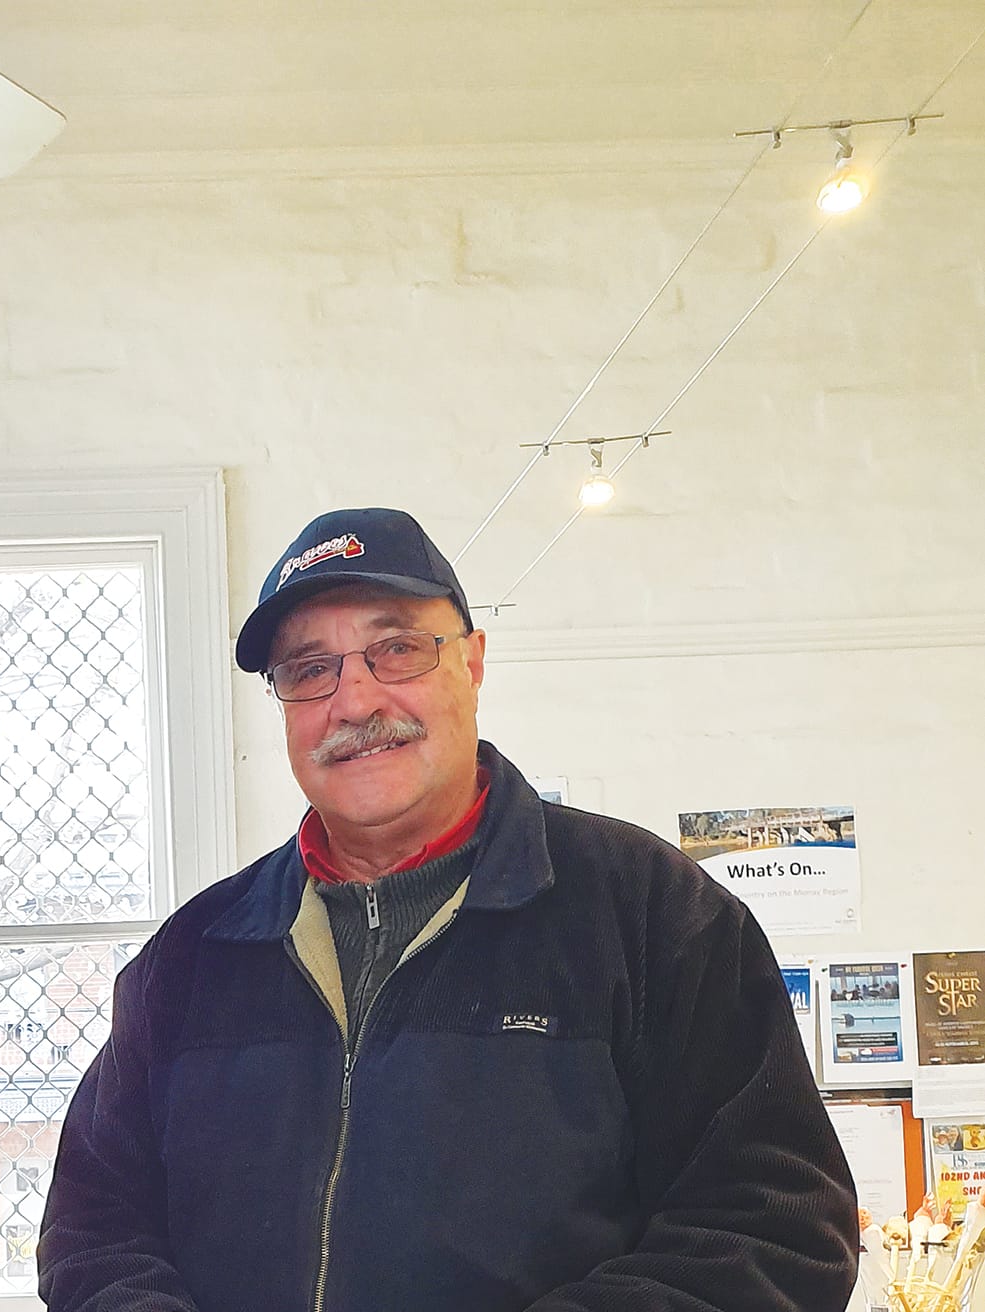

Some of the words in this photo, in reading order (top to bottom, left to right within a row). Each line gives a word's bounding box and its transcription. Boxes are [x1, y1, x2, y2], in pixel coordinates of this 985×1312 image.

[727, 862, 784, 878] What's
[789, 862, 826, 876] On...
[925, 971, 982, 994] SUPER
[938, 990, 978, 1016] STAR
[503, 1015, 548, 1026] RIVERS
